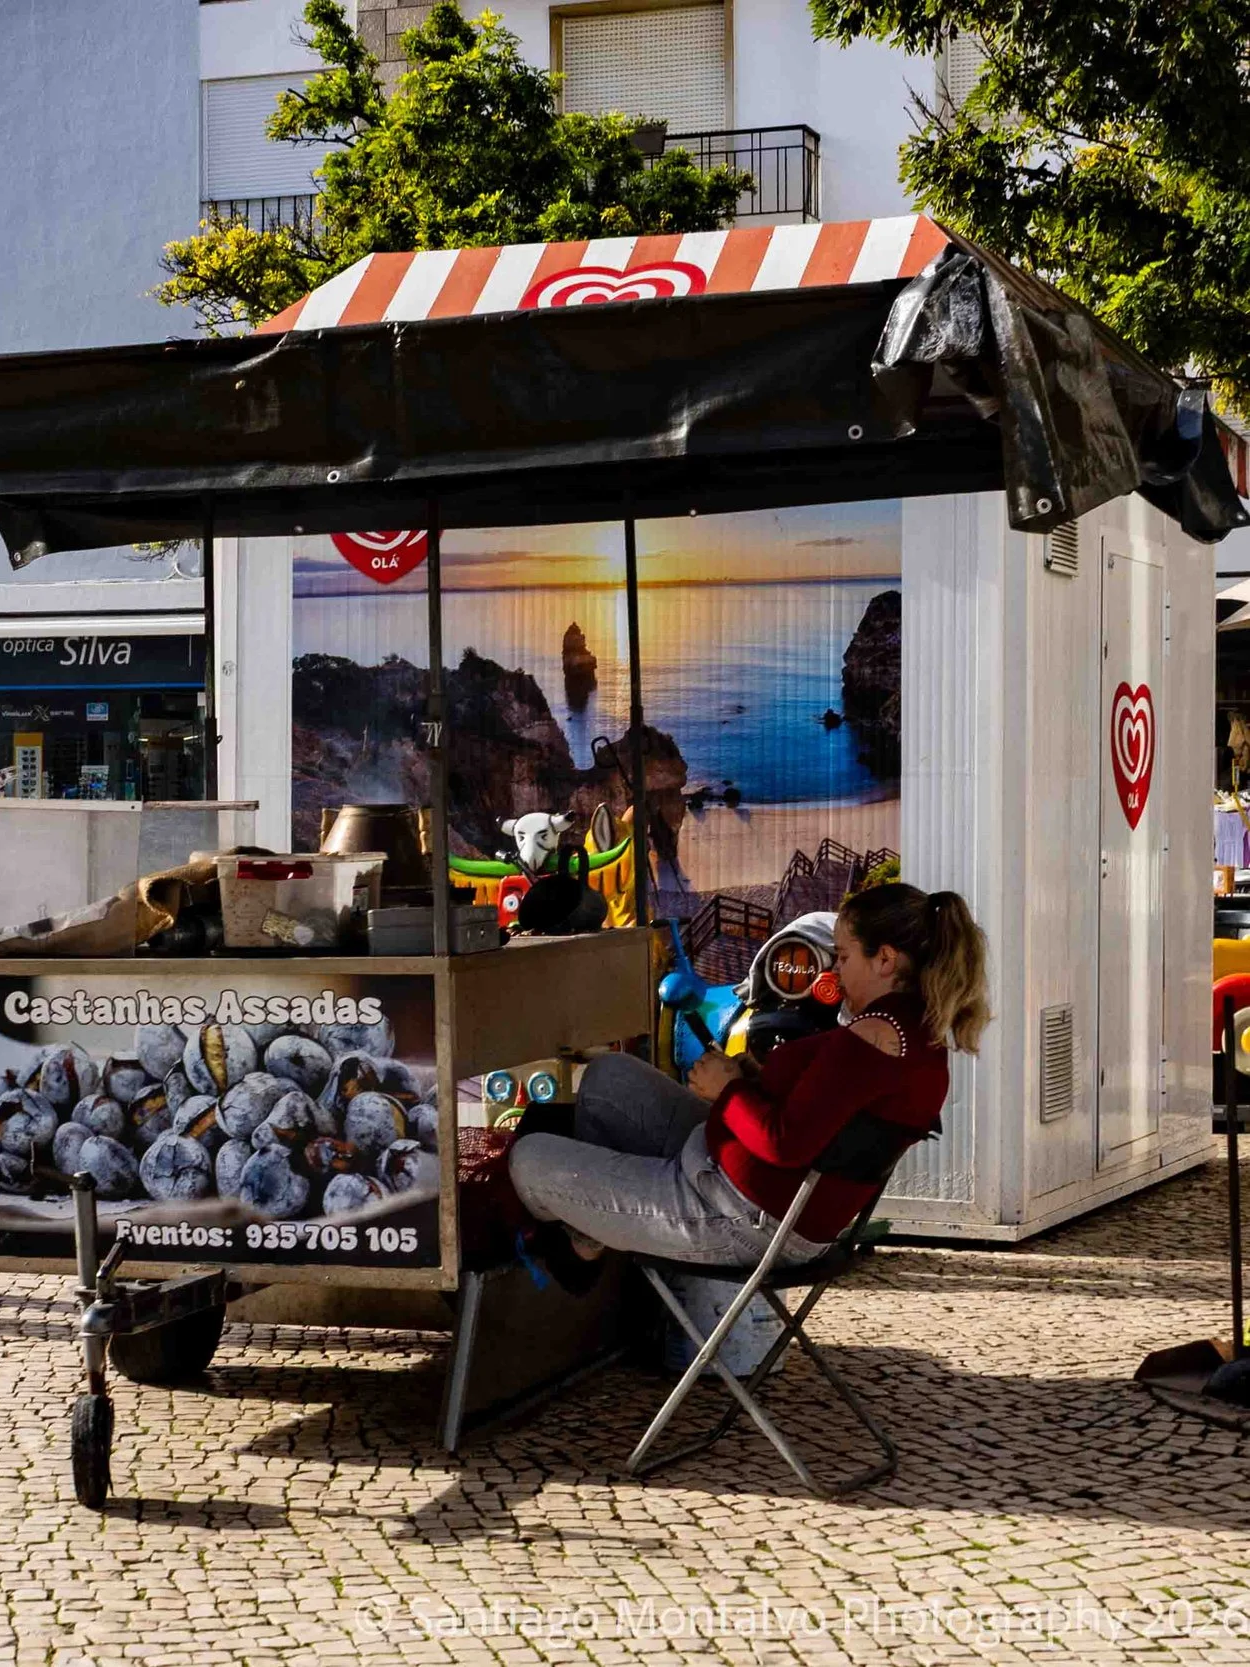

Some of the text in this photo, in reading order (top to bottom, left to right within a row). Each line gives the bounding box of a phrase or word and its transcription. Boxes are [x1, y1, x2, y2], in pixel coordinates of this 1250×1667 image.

[371, 554, 399, 569] OLÁ
[60, 635, 131, 665] Silva
[772, 961, 816, 974] TEQUILA
[3, 989, 384, 1025] Castanhas Assadas
[115, 1219, 419, 1253] Eventos: 935 705 105
